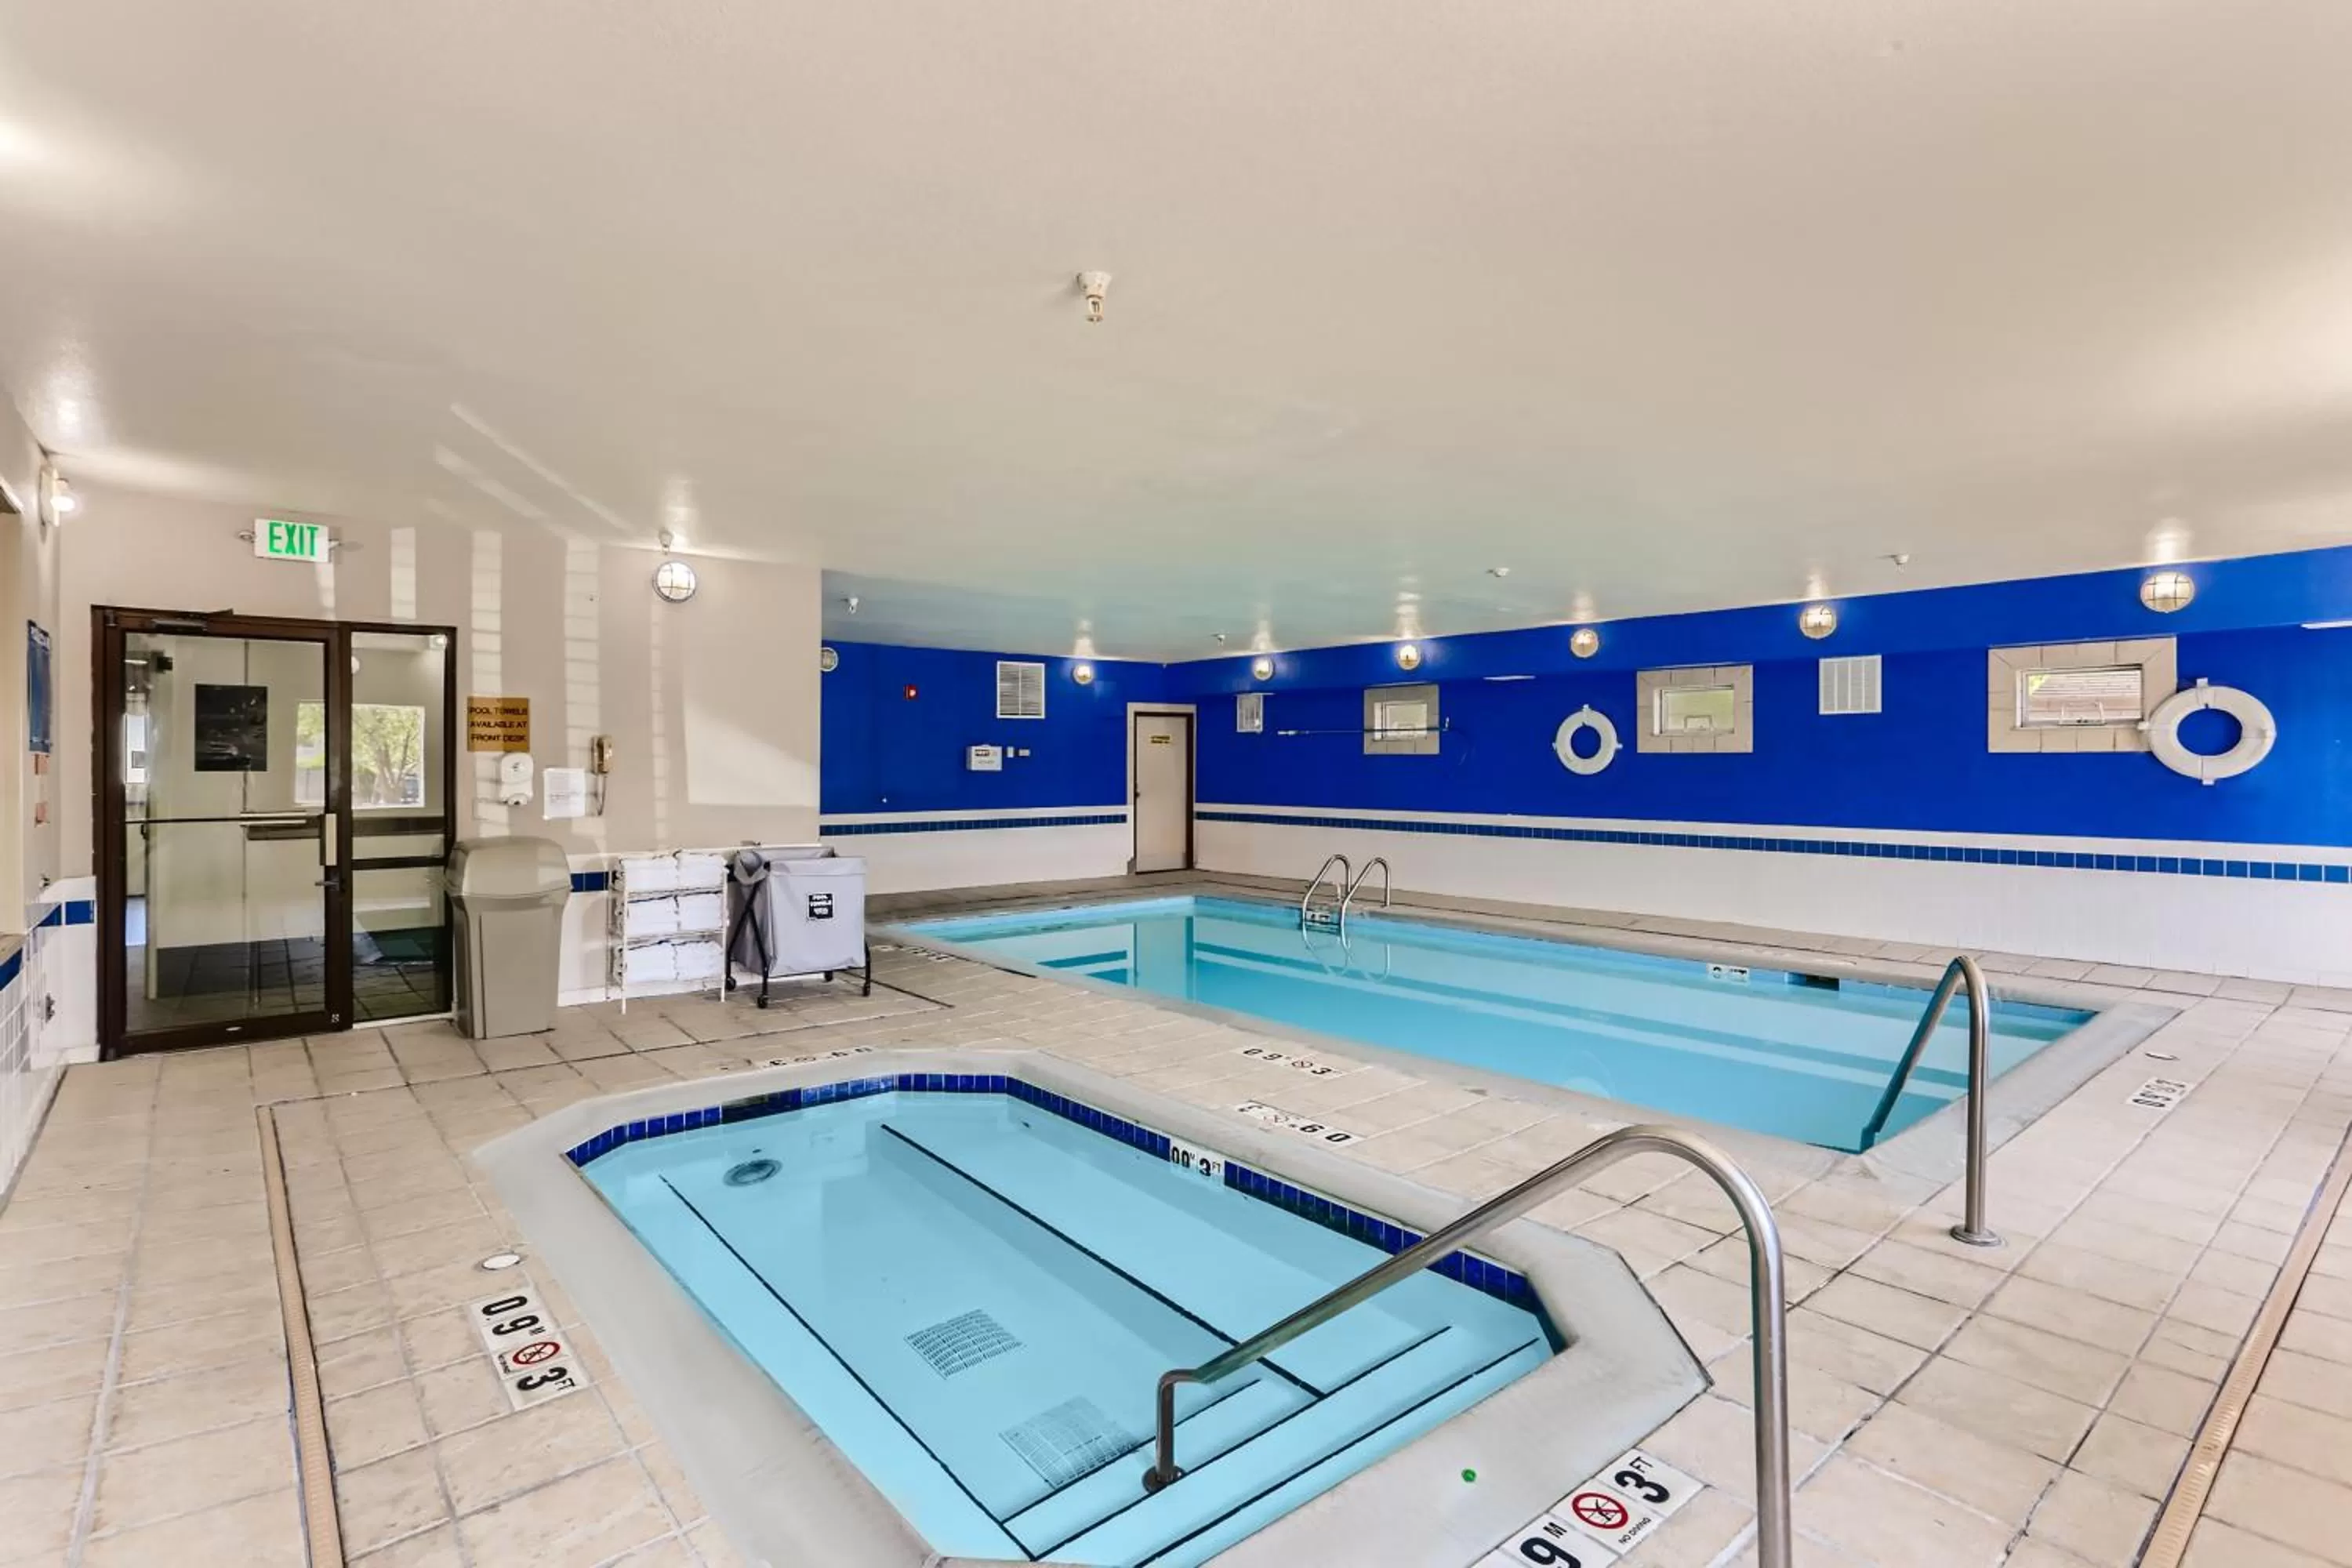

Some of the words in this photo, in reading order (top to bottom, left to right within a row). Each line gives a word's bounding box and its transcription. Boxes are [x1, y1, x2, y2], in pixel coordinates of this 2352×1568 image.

[269, 521, 318, 556] EXIT
[469, 706, 492, 715] POOL
[469, 720, 515, 728] AVAILABLE
[516, 720, 528, 728] AT
[470, 733, 500, 742] FRONT
[516, 1366, 569, 1392] 3
[1628, 1455, 1654, 1474] FT
[1613, 1469, 1671, 1504] 3
[1617, 1534, 1632, 1545] NO
